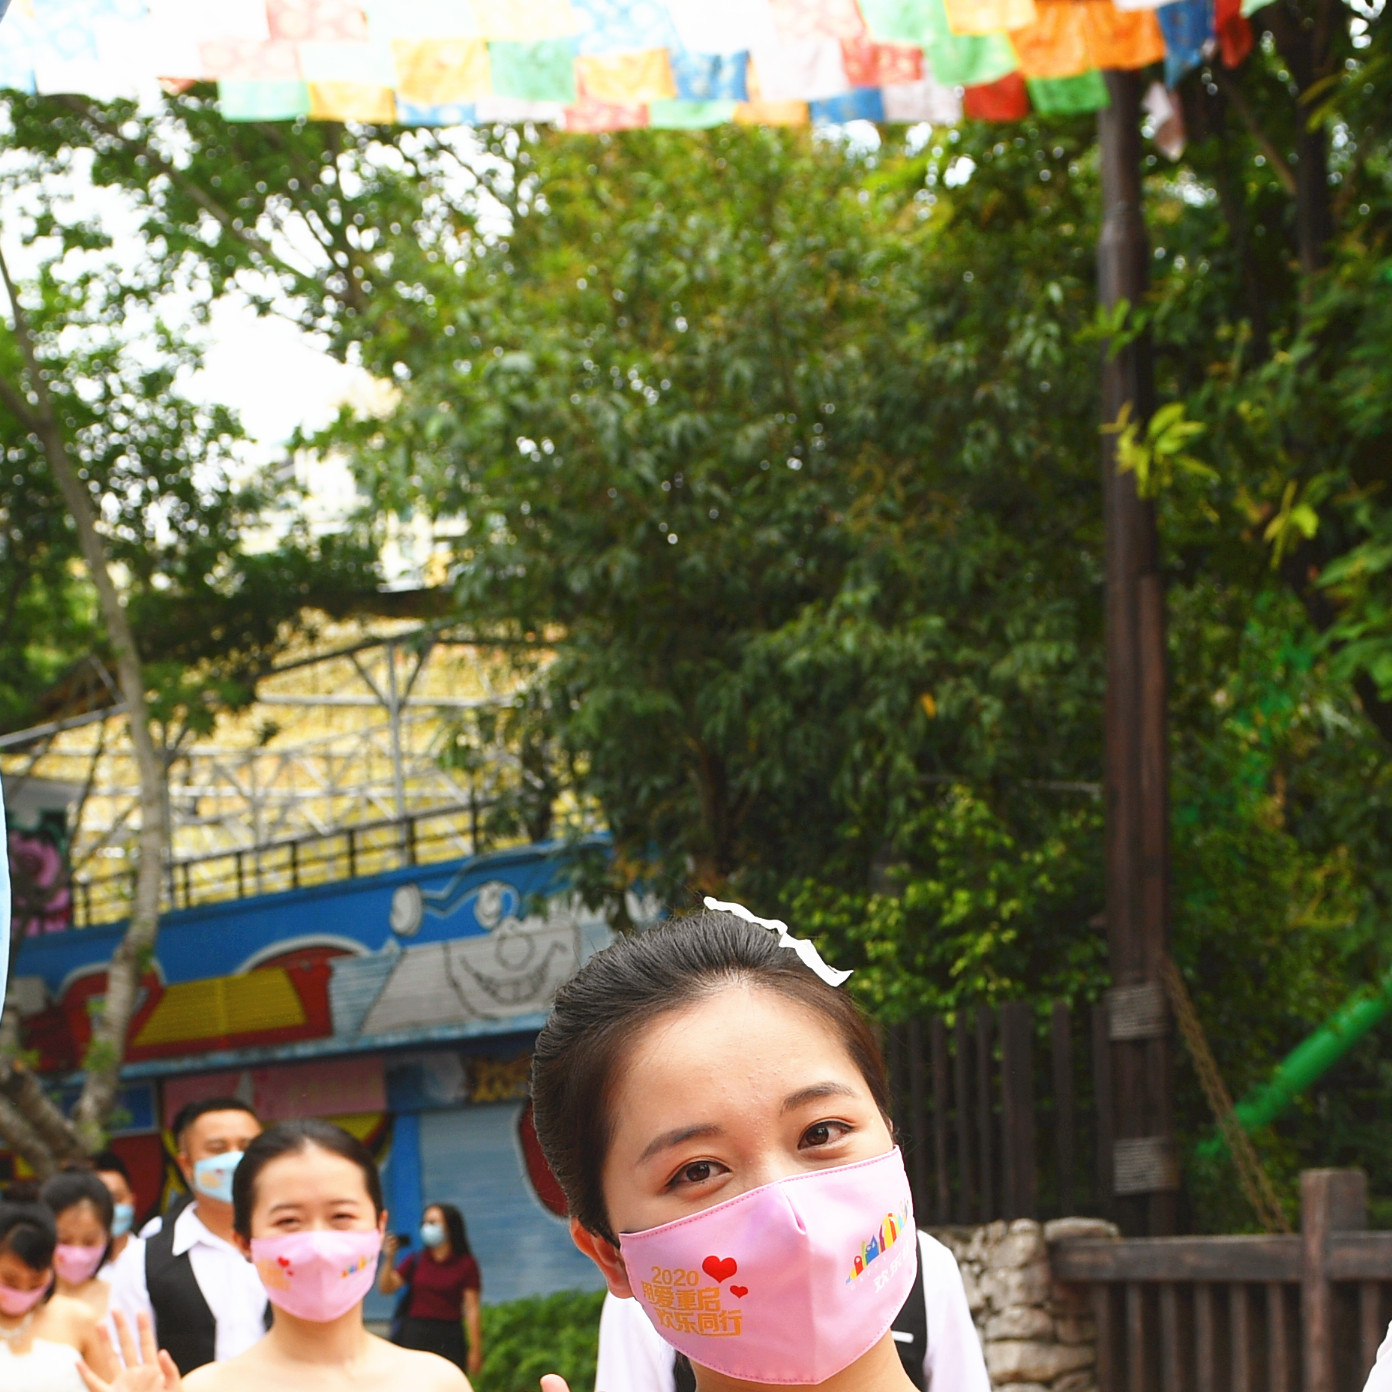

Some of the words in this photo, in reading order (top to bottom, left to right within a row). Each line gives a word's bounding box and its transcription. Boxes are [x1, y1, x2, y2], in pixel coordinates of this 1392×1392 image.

[651, 1266, 700, 1287] 2020
[641, 1281, 721, 1311] 用爱重启
[654, 1306, 742, 1337] 欢乐同行
